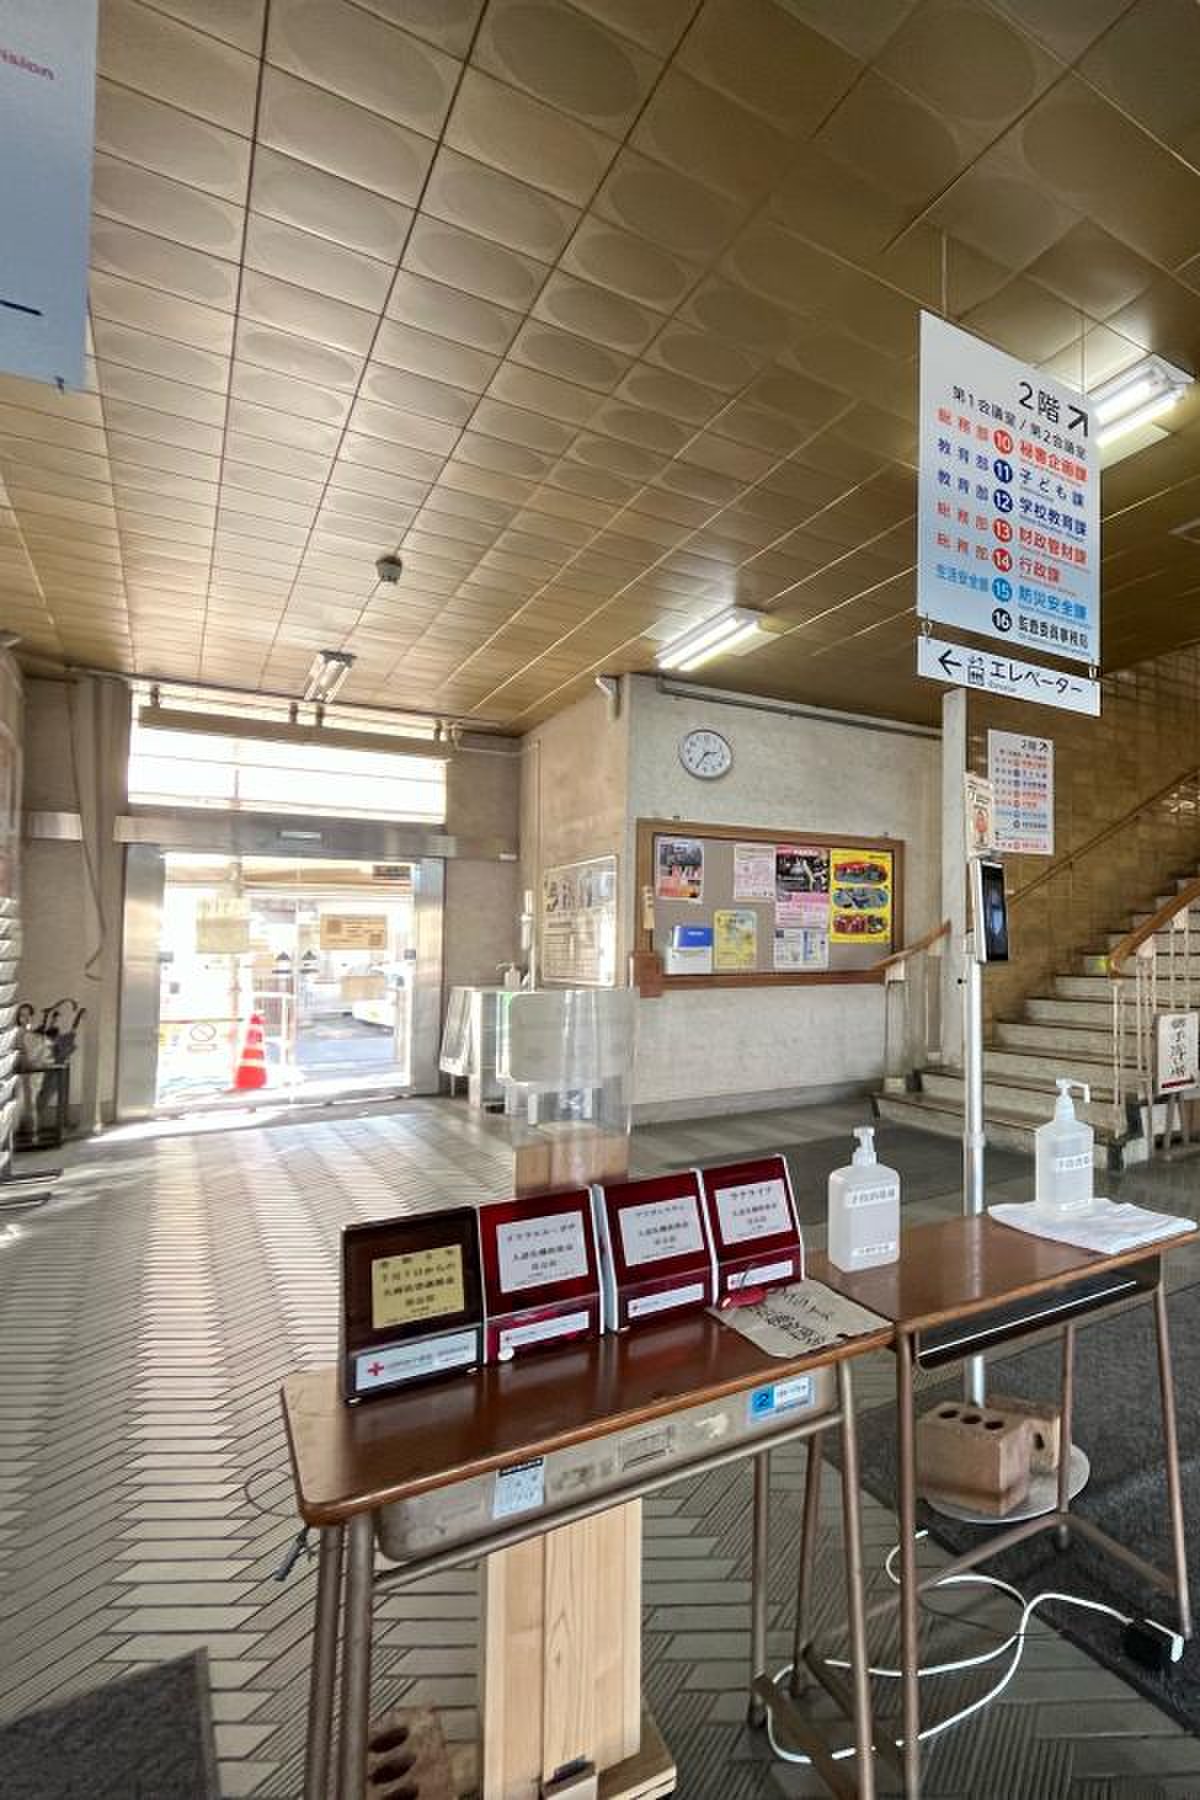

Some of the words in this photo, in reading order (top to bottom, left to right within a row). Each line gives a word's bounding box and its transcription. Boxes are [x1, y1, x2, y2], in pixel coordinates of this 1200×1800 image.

[1018, 381, 1060, 424] 2階
[993, 430, 1013, 454] 10
[994, 459, 1013, 483] 11
[994, 489, 1013, 513] 12
[1019, 497, 1087, 536] 学校教育課
[992, 578, 1012, 602] 15
[992, 608, 1012, 632] 16
[990, 661, 1083, 694] エレベーター
